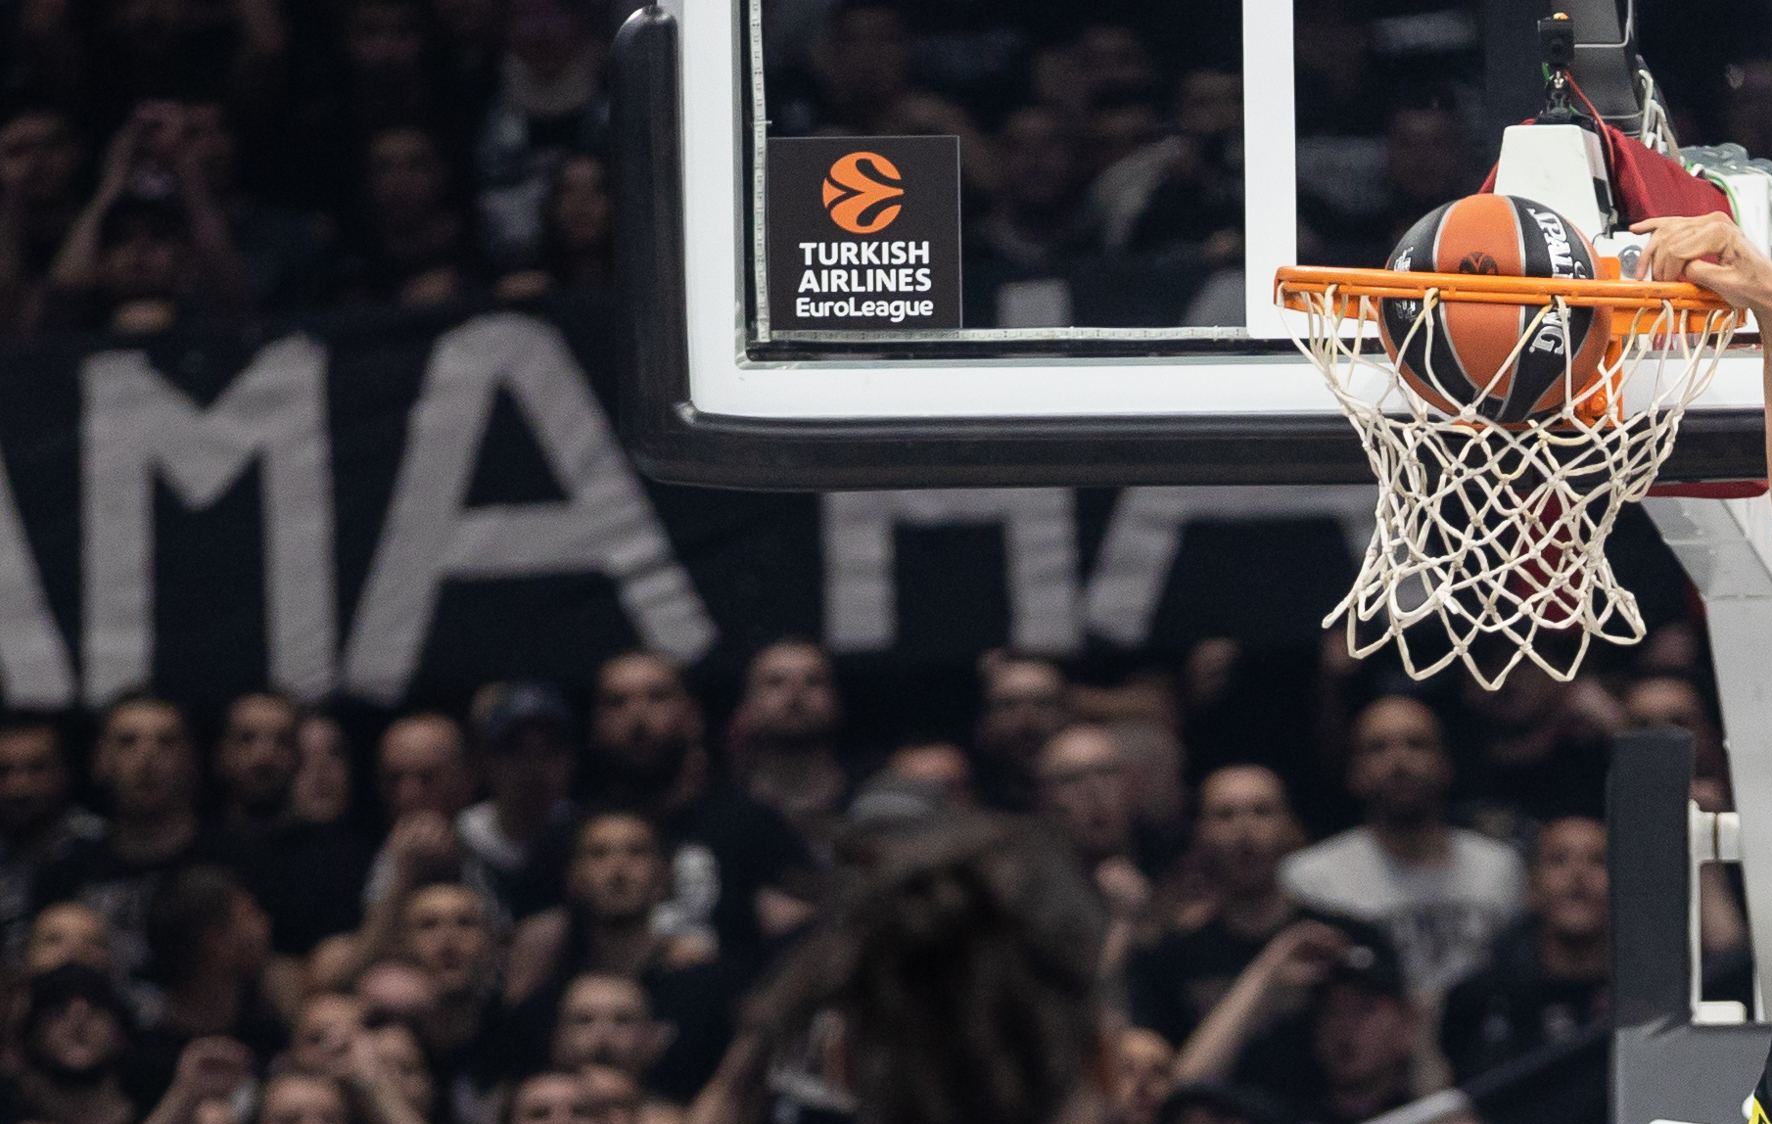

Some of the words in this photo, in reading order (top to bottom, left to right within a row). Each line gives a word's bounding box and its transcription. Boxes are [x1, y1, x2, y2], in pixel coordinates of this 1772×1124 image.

[798, 240, 931, 266] TURKISH
[797, 267, 933, 294] AIRLINES
[1526, 208, 1573, 355] SPALNG
[795, 296, 934, 323] EuroLeague
